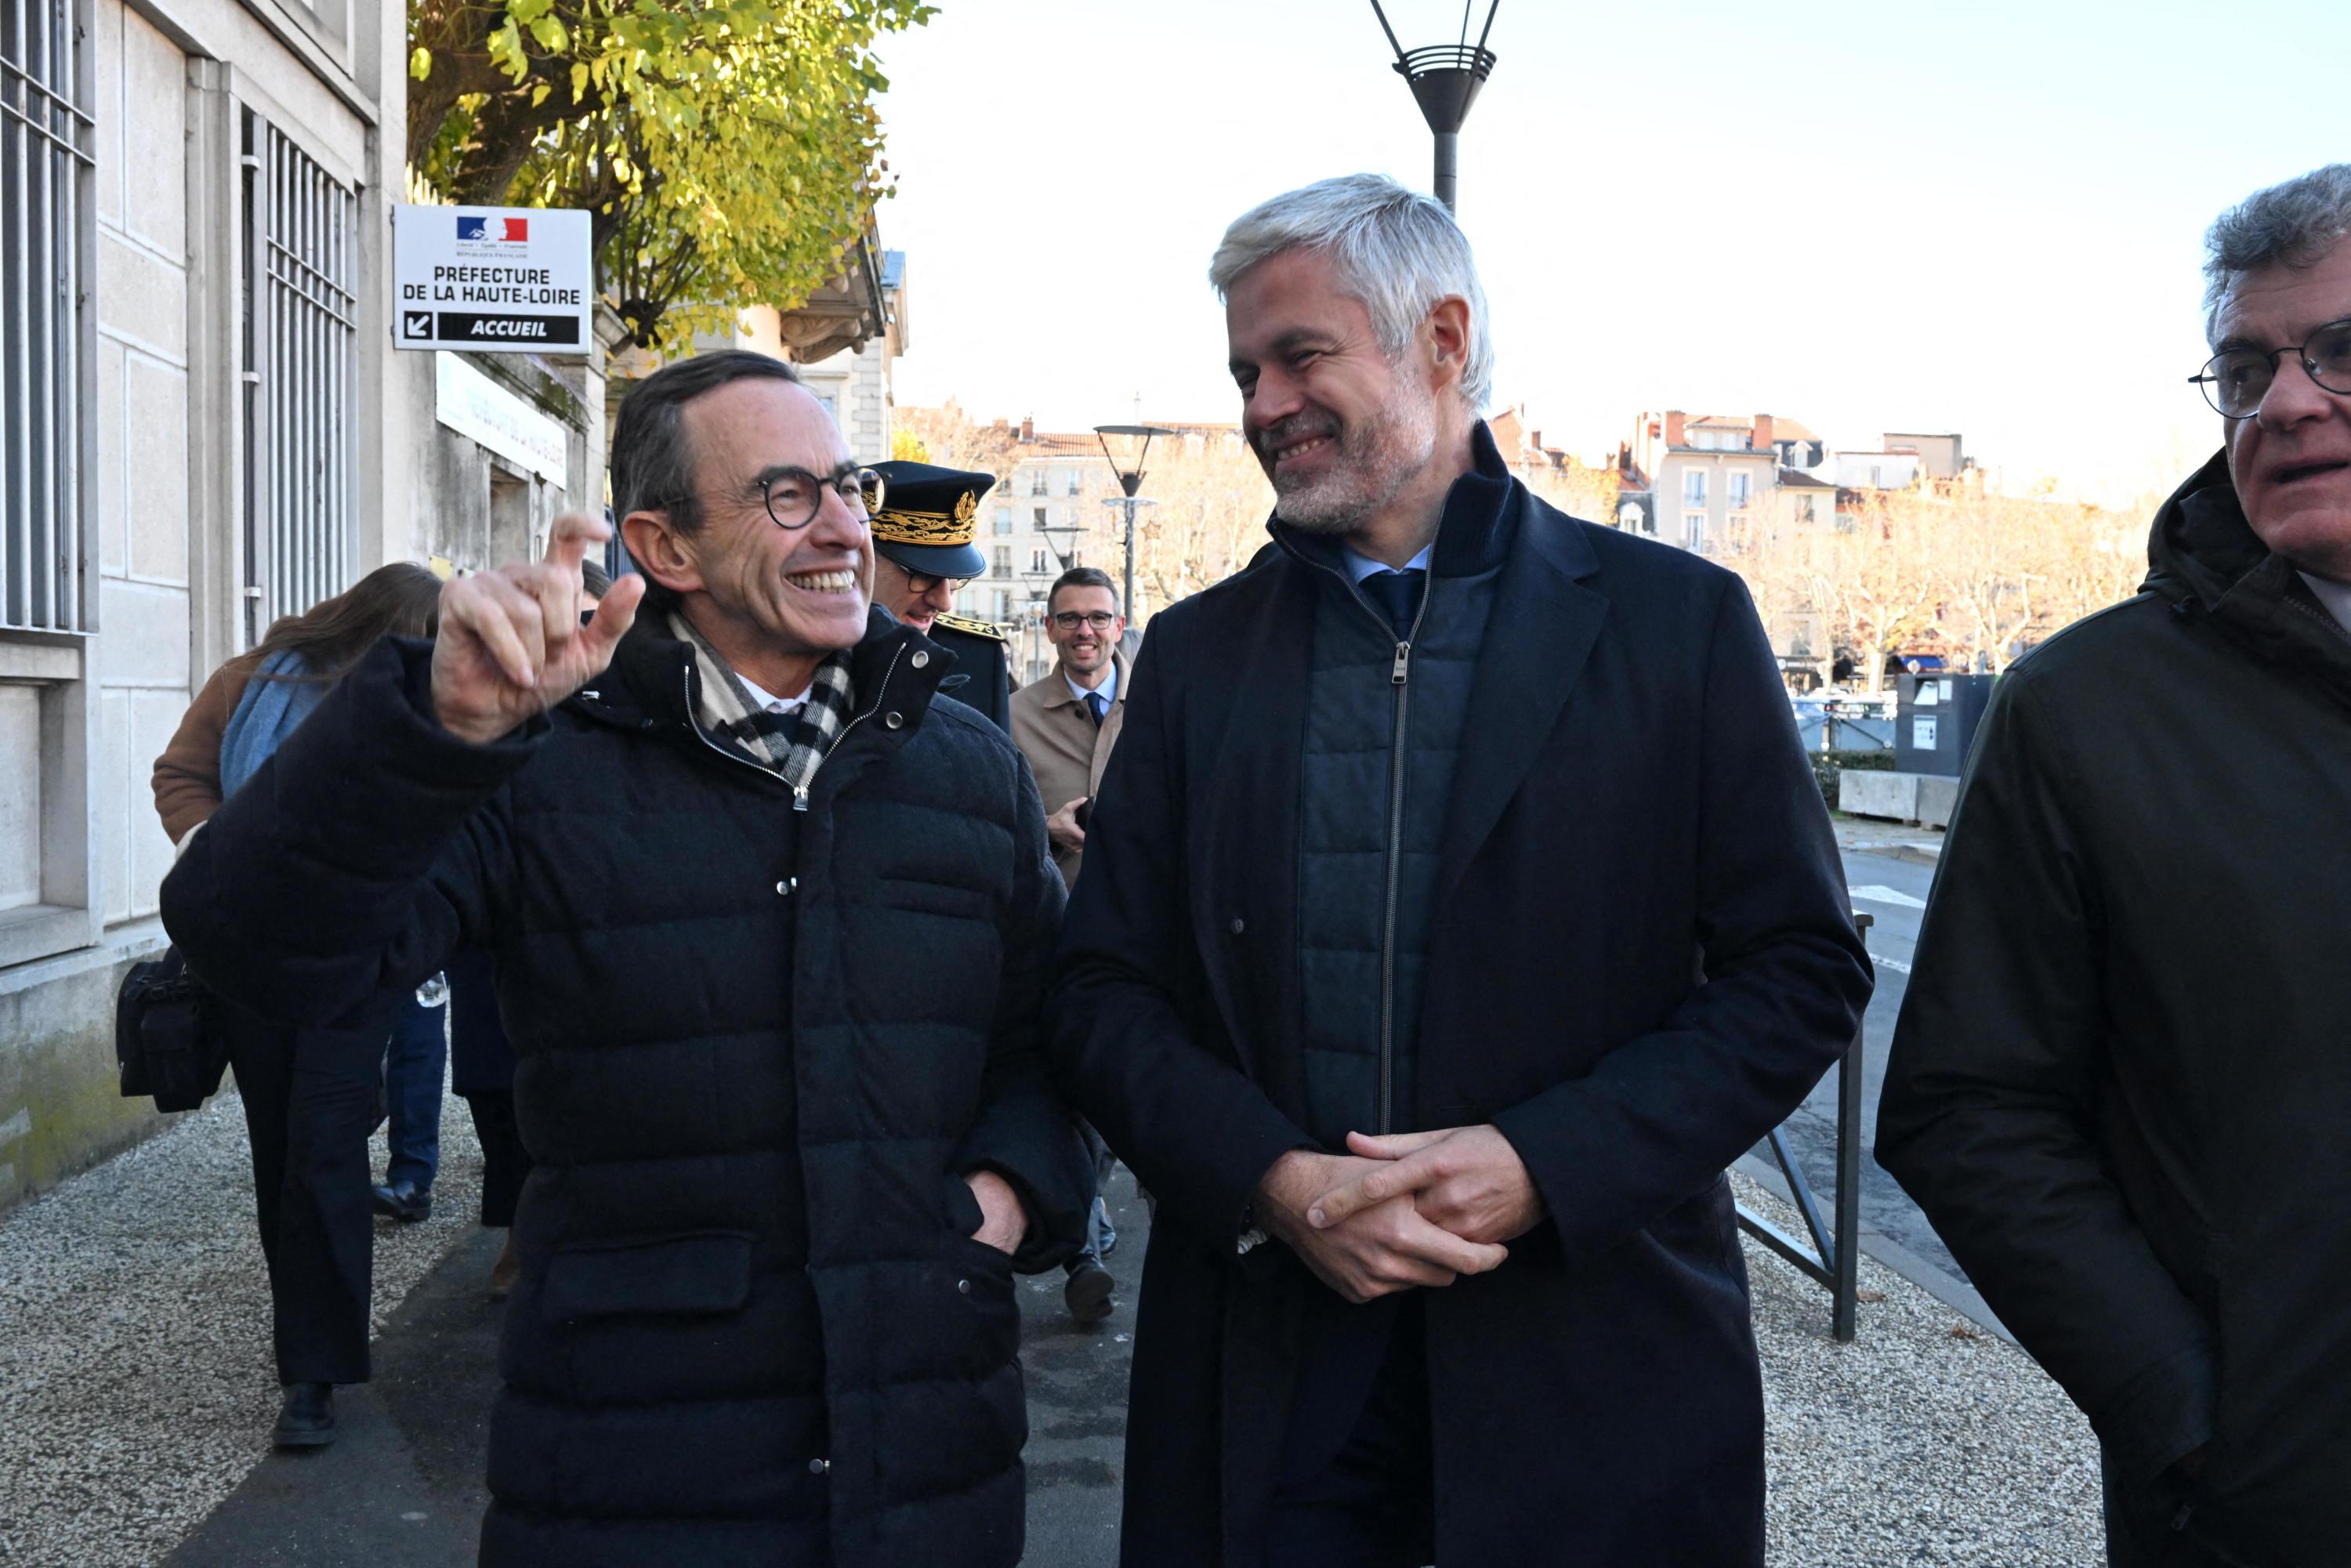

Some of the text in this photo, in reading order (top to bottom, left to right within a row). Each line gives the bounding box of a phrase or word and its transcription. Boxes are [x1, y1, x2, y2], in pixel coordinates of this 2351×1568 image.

[434, 264, 550, 284] PRÉFECTURE
[404, 284, 580, 304] DE LA HAUTE-LOIRE
[470, 320, 547, 337] ACCUEIL
